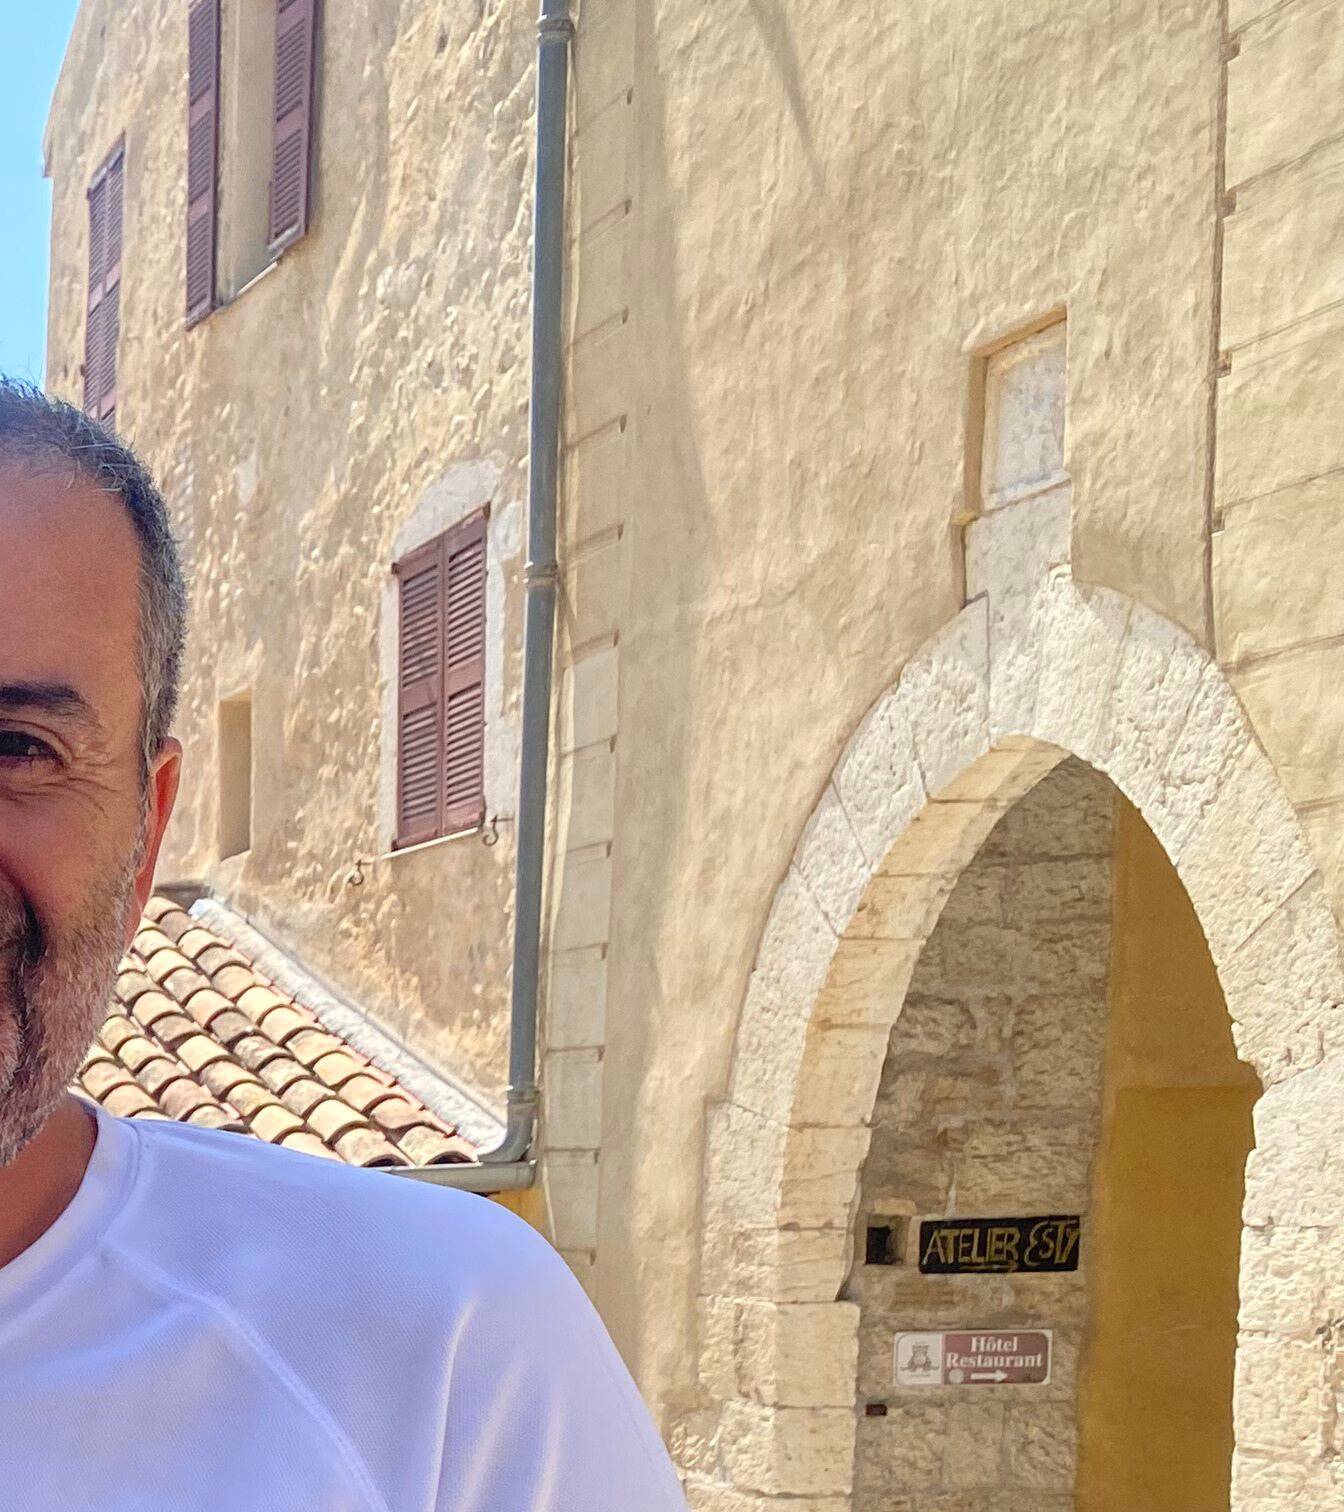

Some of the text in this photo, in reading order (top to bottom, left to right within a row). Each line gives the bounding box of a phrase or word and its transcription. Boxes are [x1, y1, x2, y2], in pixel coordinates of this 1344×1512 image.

[922, 1227, 1020, 1264] ATELIER
[970, 1336, 1018, 1352] Hôtel
[946, 1352, 1042, 1368] Restaurant
